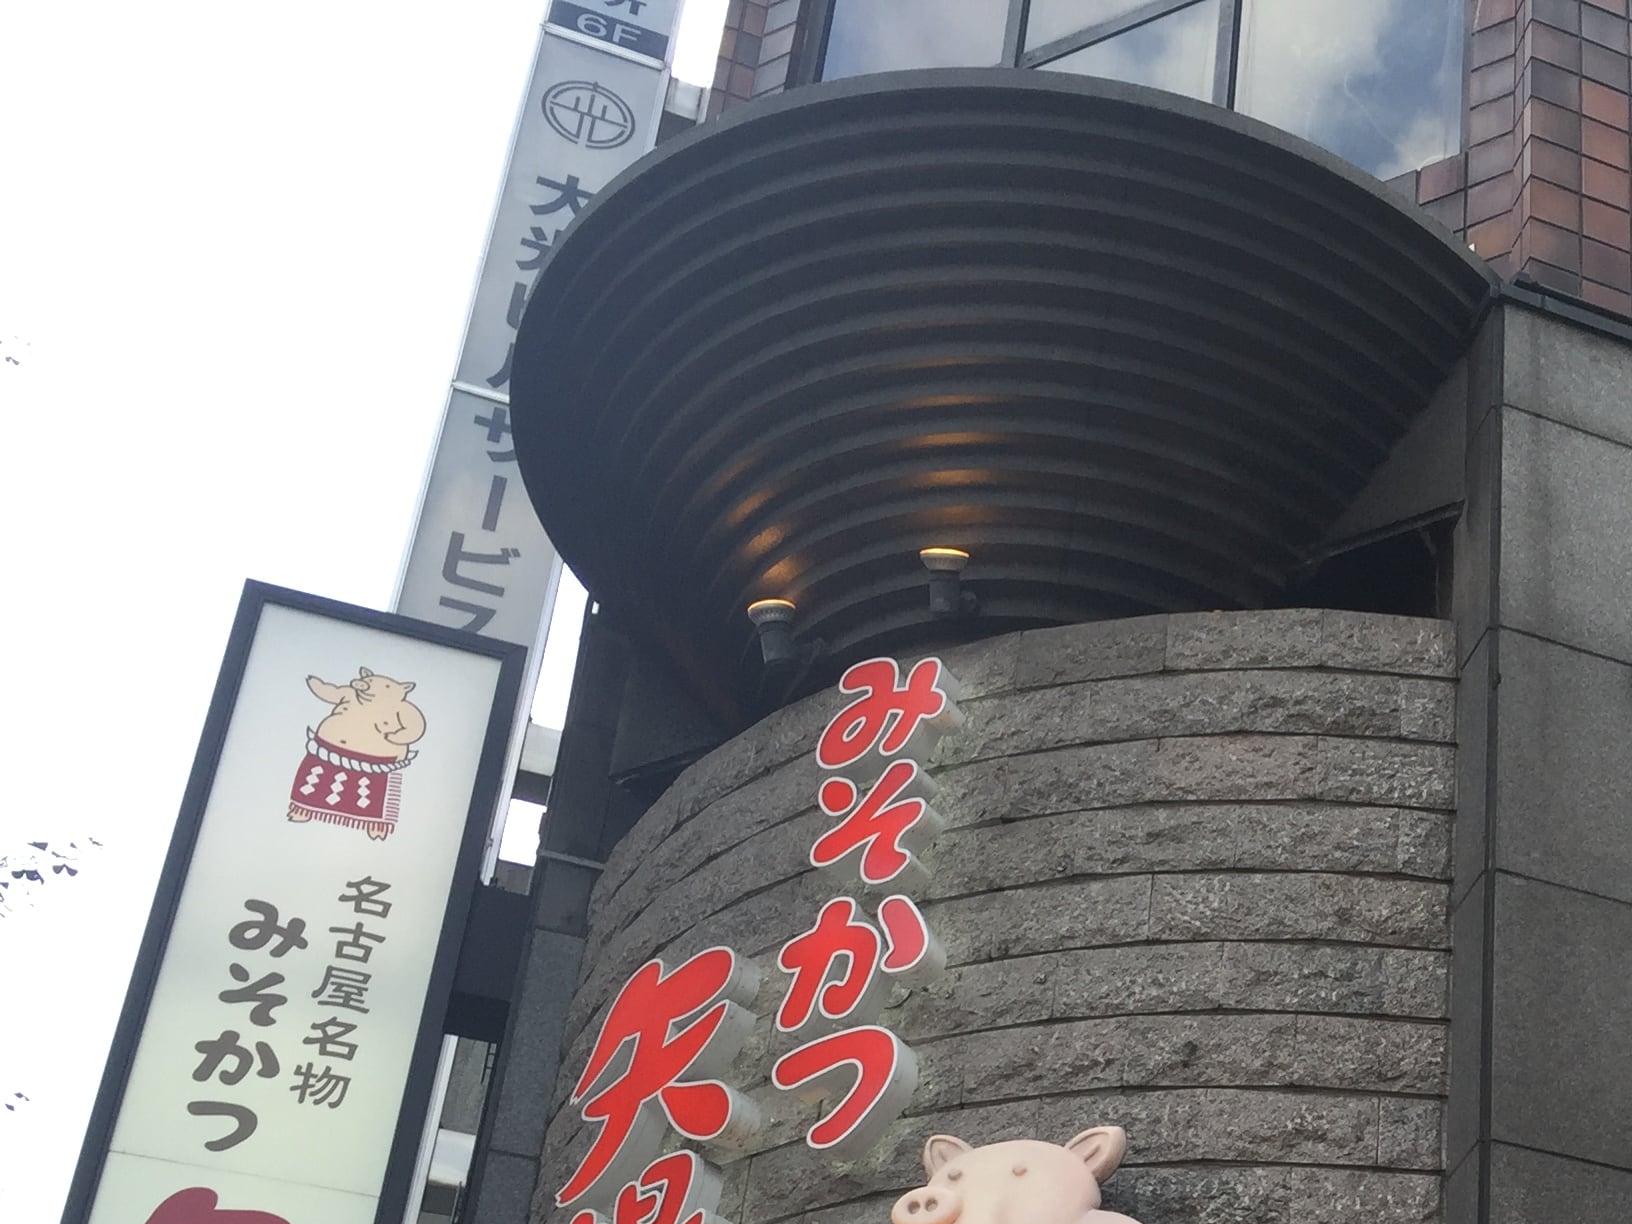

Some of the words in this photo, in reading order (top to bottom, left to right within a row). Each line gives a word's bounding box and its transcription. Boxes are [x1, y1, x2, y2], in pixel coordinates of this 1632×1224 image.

[576, 13, 642, 44] 6F
[289, 875, 394, 1109] 名古屋名物
[772, 656, 948, 1150] みそかつ
[186, 899, 309, 1152] みそかつ
